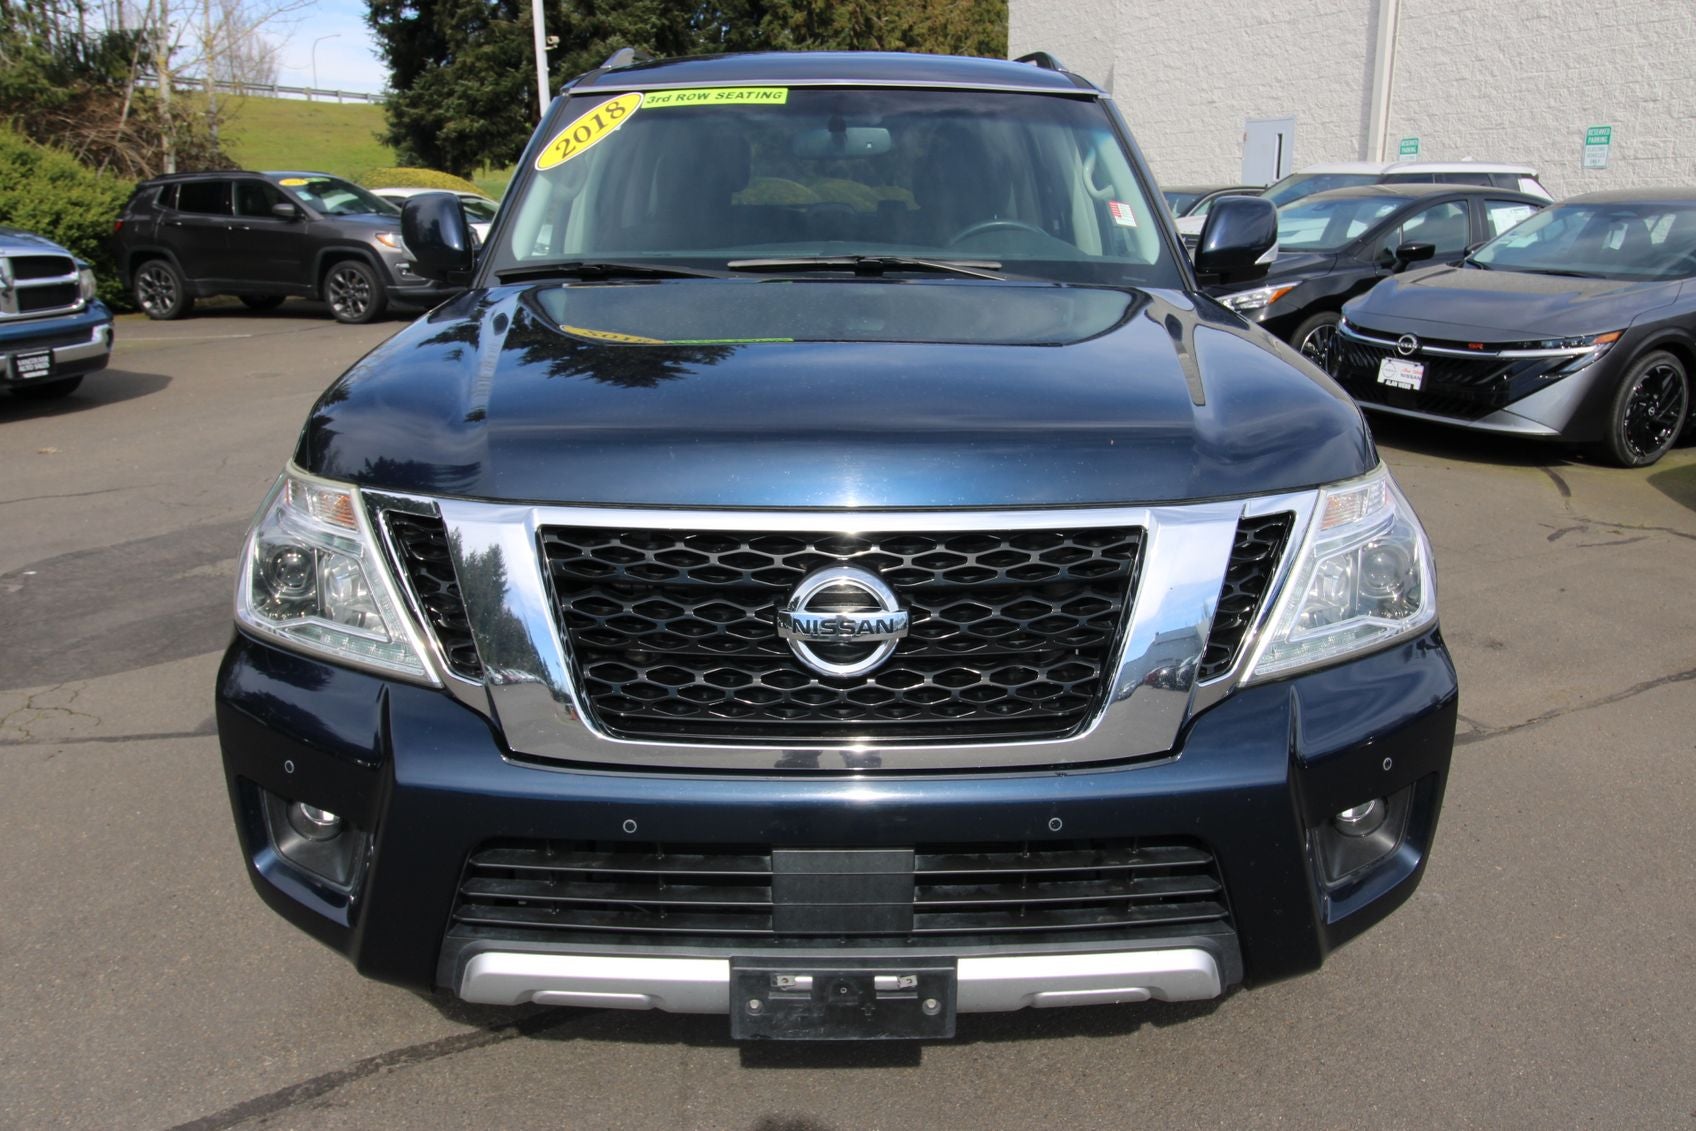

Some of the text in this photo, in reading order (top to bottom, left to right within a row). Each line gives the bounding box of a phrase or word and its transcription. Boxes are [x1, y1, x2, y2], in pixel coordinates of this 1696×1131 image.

[646, 91, 783, 104] 3rd ROW SEATING
[555, 101, 626, 160] 2018
[792, 618, 894, 635] NISSAN
